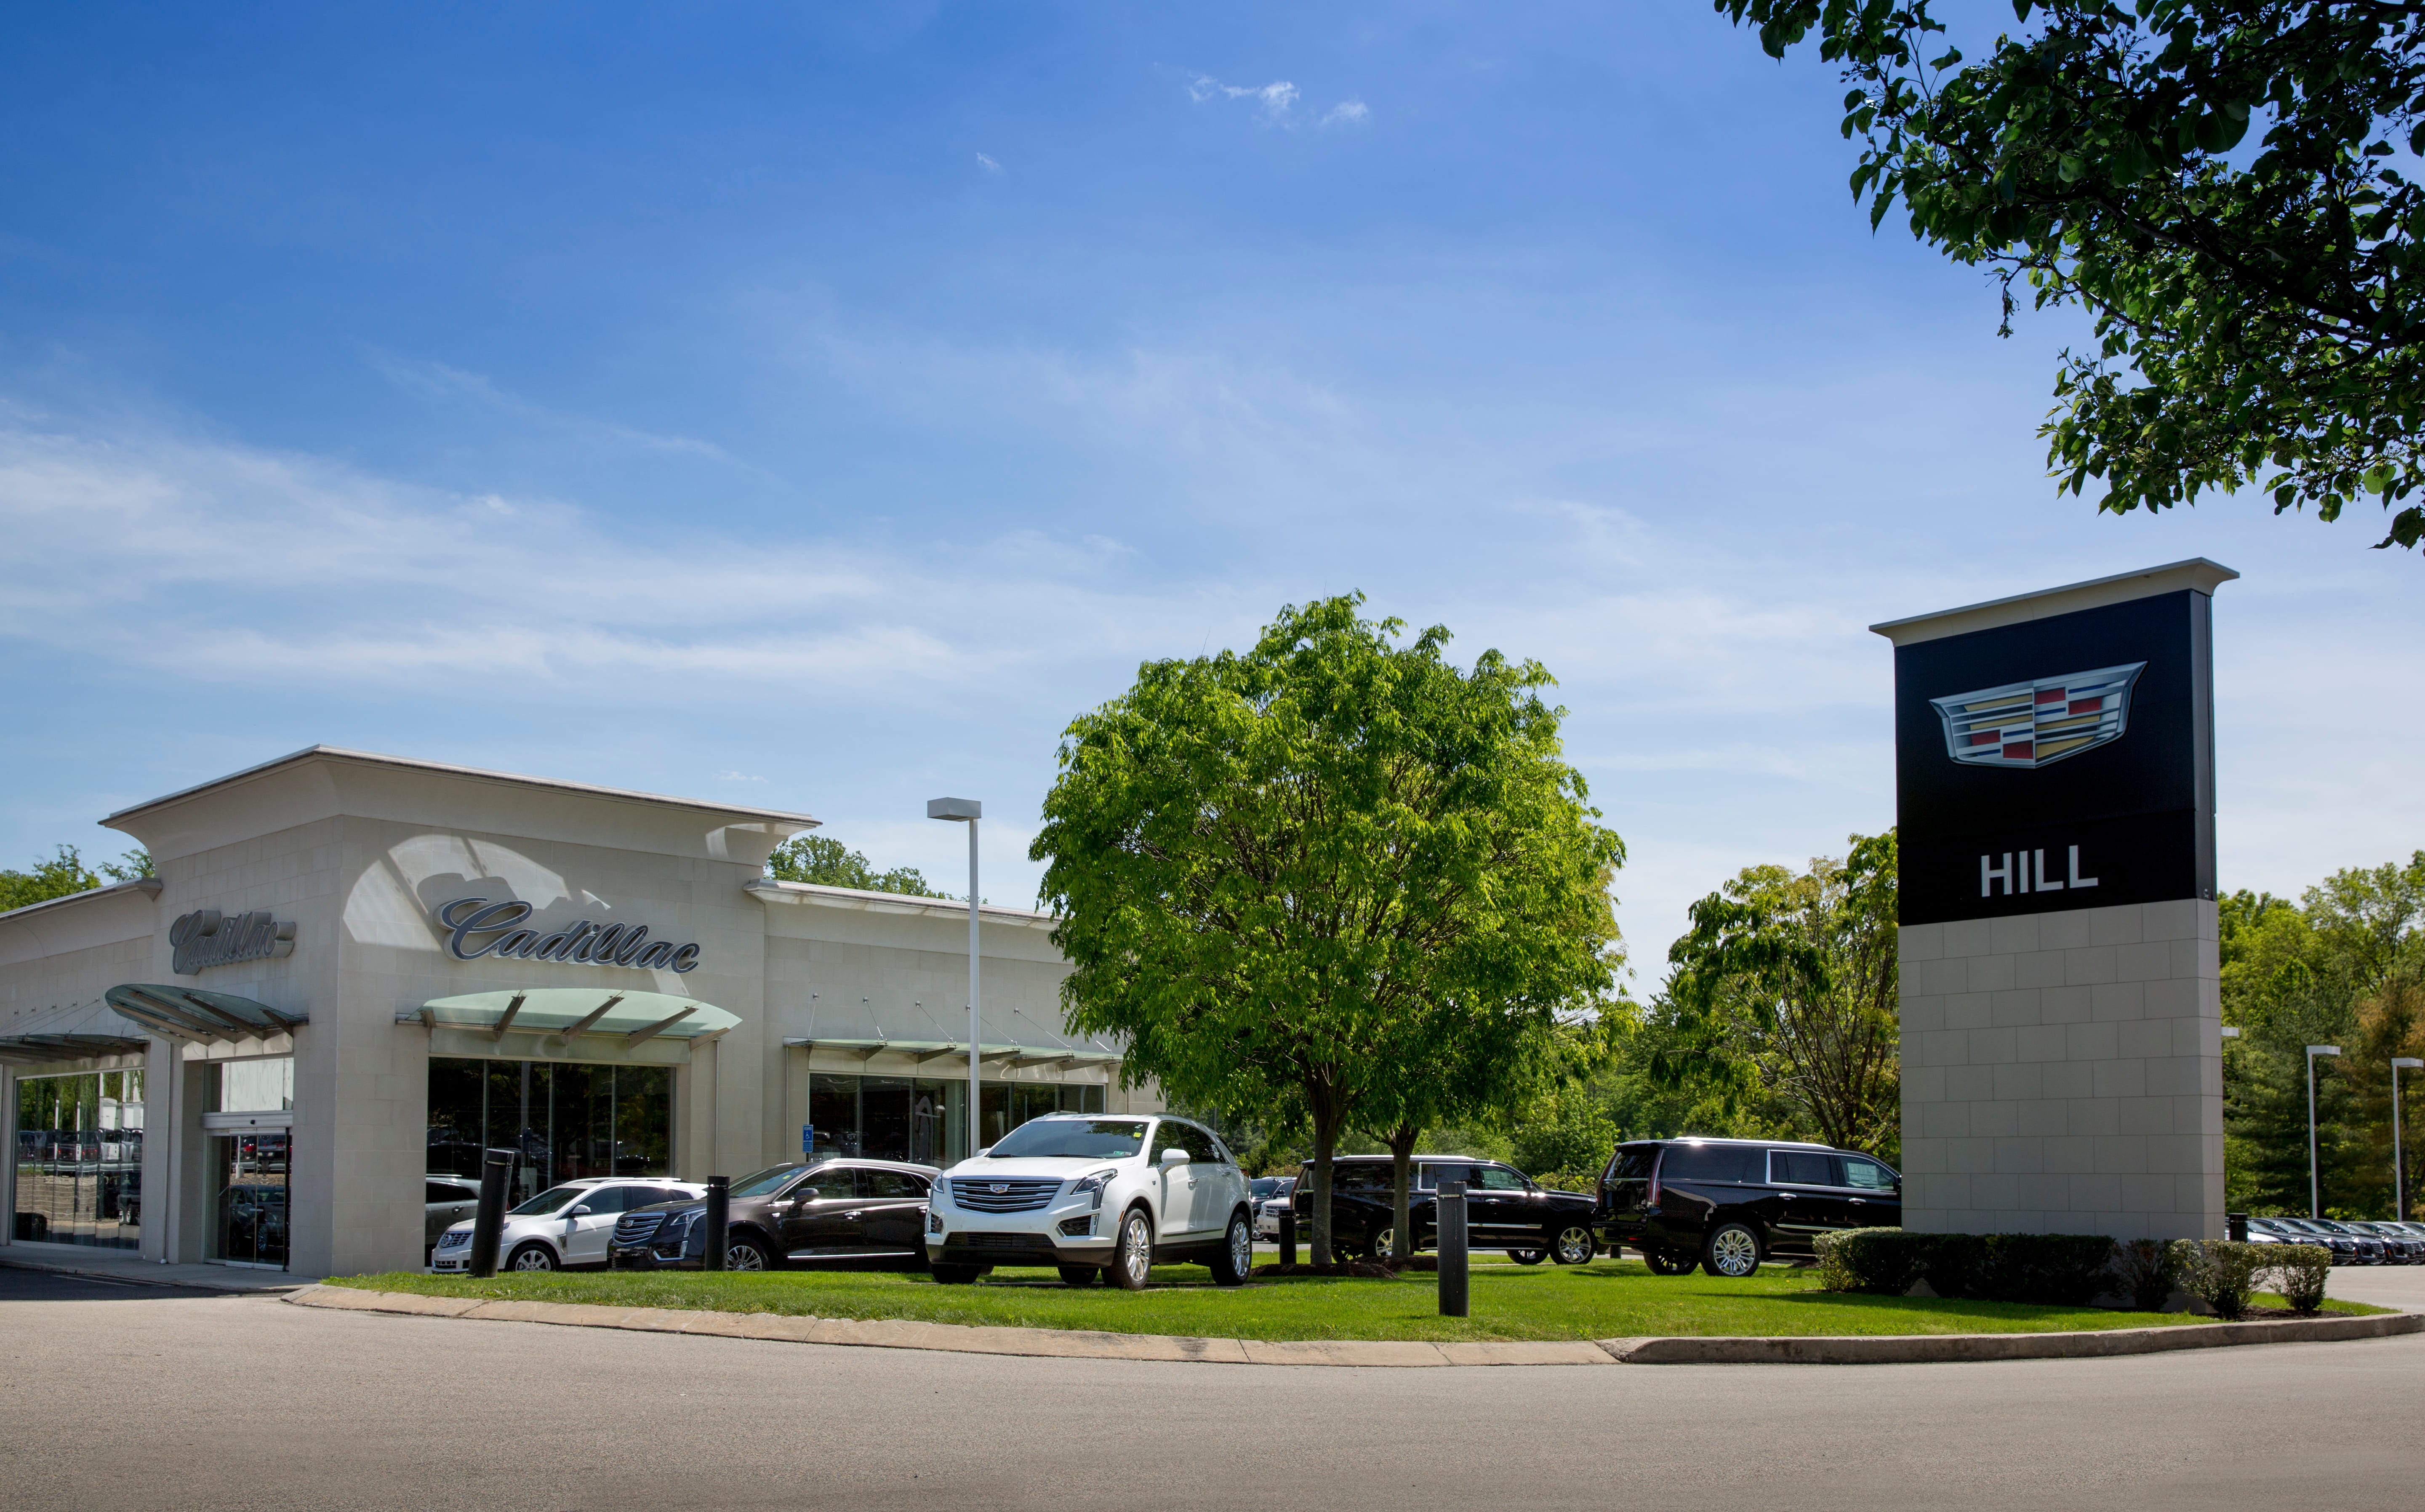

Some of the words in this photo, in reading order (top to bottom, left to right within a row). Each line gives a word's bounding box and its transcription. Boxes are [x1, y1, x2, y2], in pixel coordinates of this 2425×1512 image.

[1981, 845, 2098, 897] HILL
[169, 909, 280, 974] Cadillac
[439, 896, 700, 974] Cadillac
